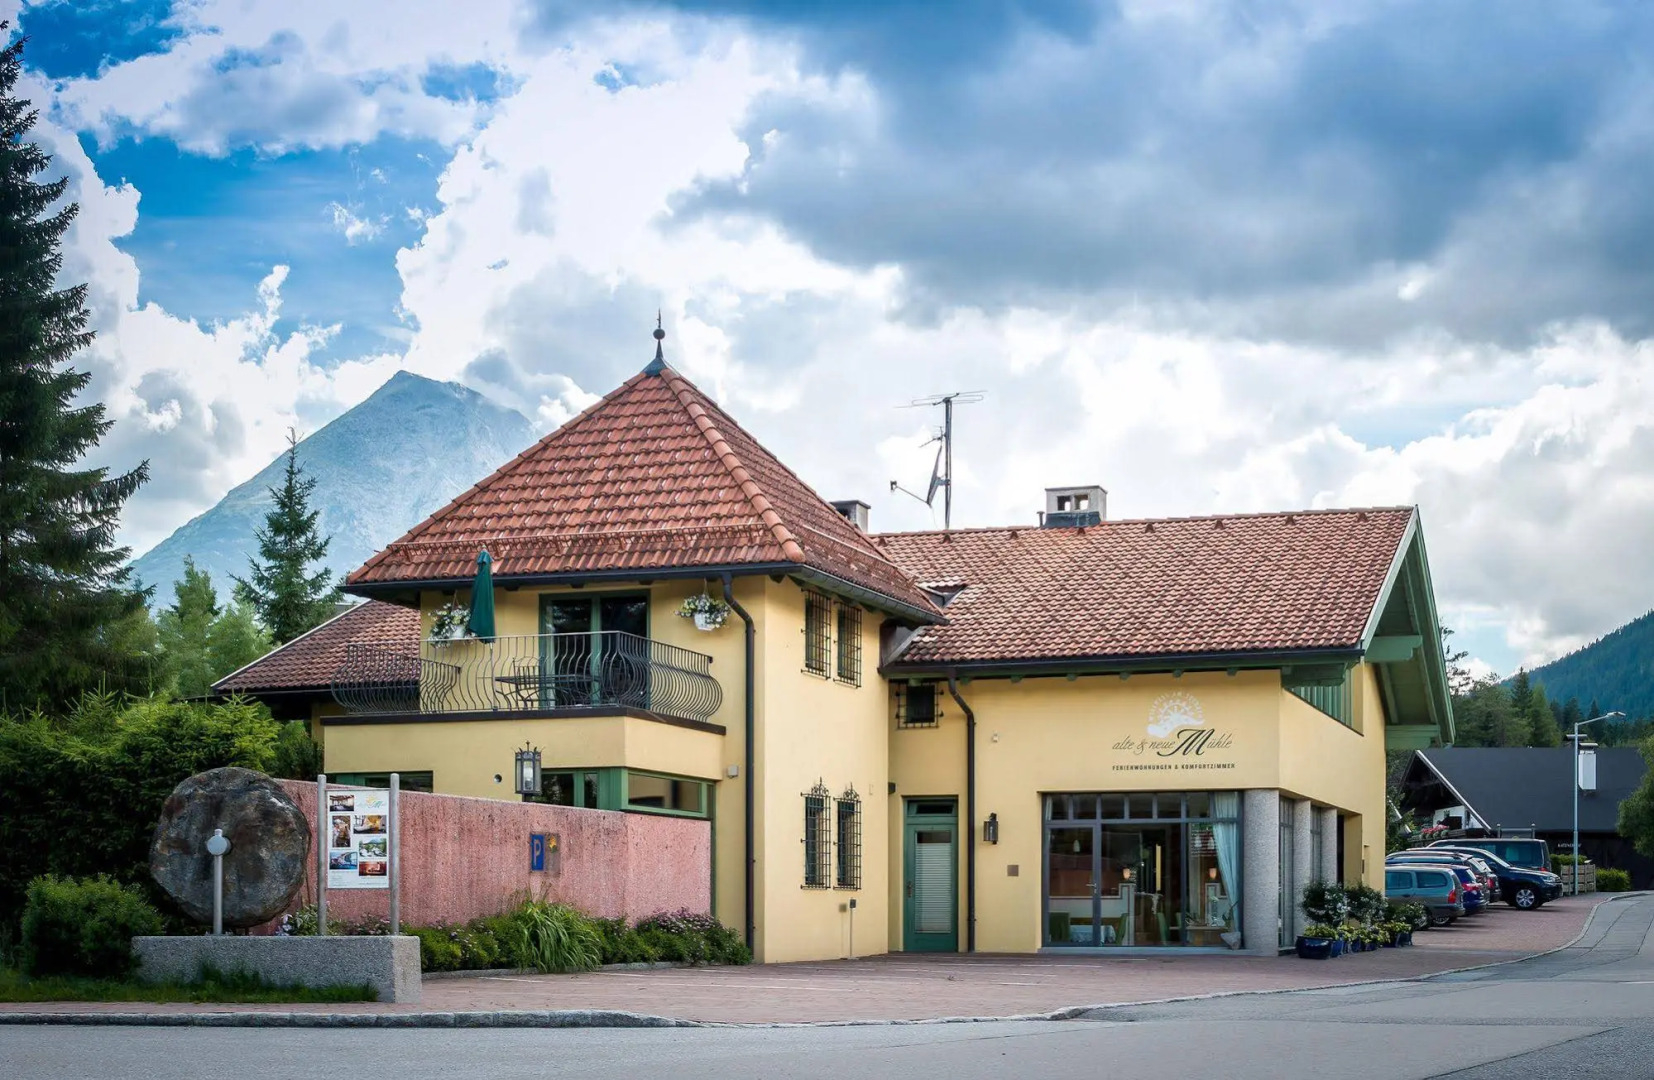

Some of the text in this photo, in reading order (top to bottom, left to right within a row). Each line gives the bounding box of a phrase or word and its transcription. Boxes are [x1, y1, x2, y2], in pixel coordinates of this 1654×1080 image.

[1112, 727, 1233, 757] alte & neue Mühle
[533, 838, 542, 867] P
